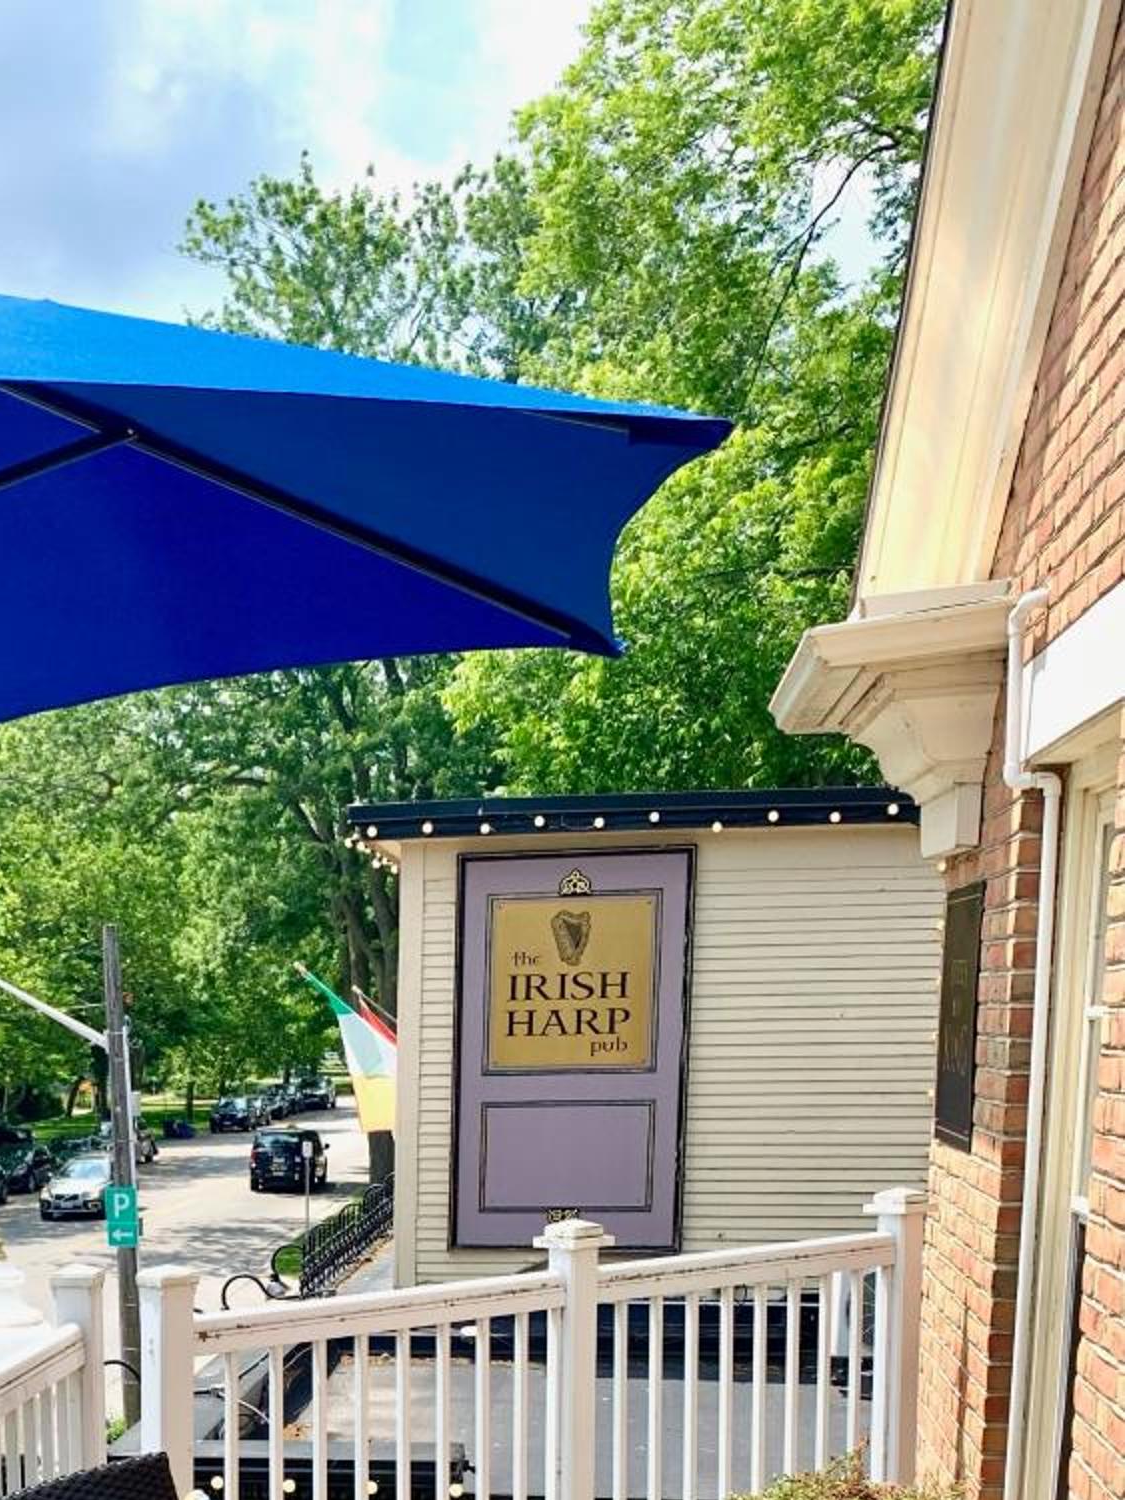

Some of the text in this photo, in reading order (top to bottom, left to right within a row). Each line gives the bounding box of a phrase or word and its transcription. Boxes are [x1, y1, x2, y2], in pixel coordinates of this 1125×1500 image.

[509, 951, 540, 967] the
[507, 971, 631, 1001] IRISH
[506, 1007, 631, 1037] HARP
[590, 1036, 628, 1057] pub
[114, 1193, 130, 1218] P
